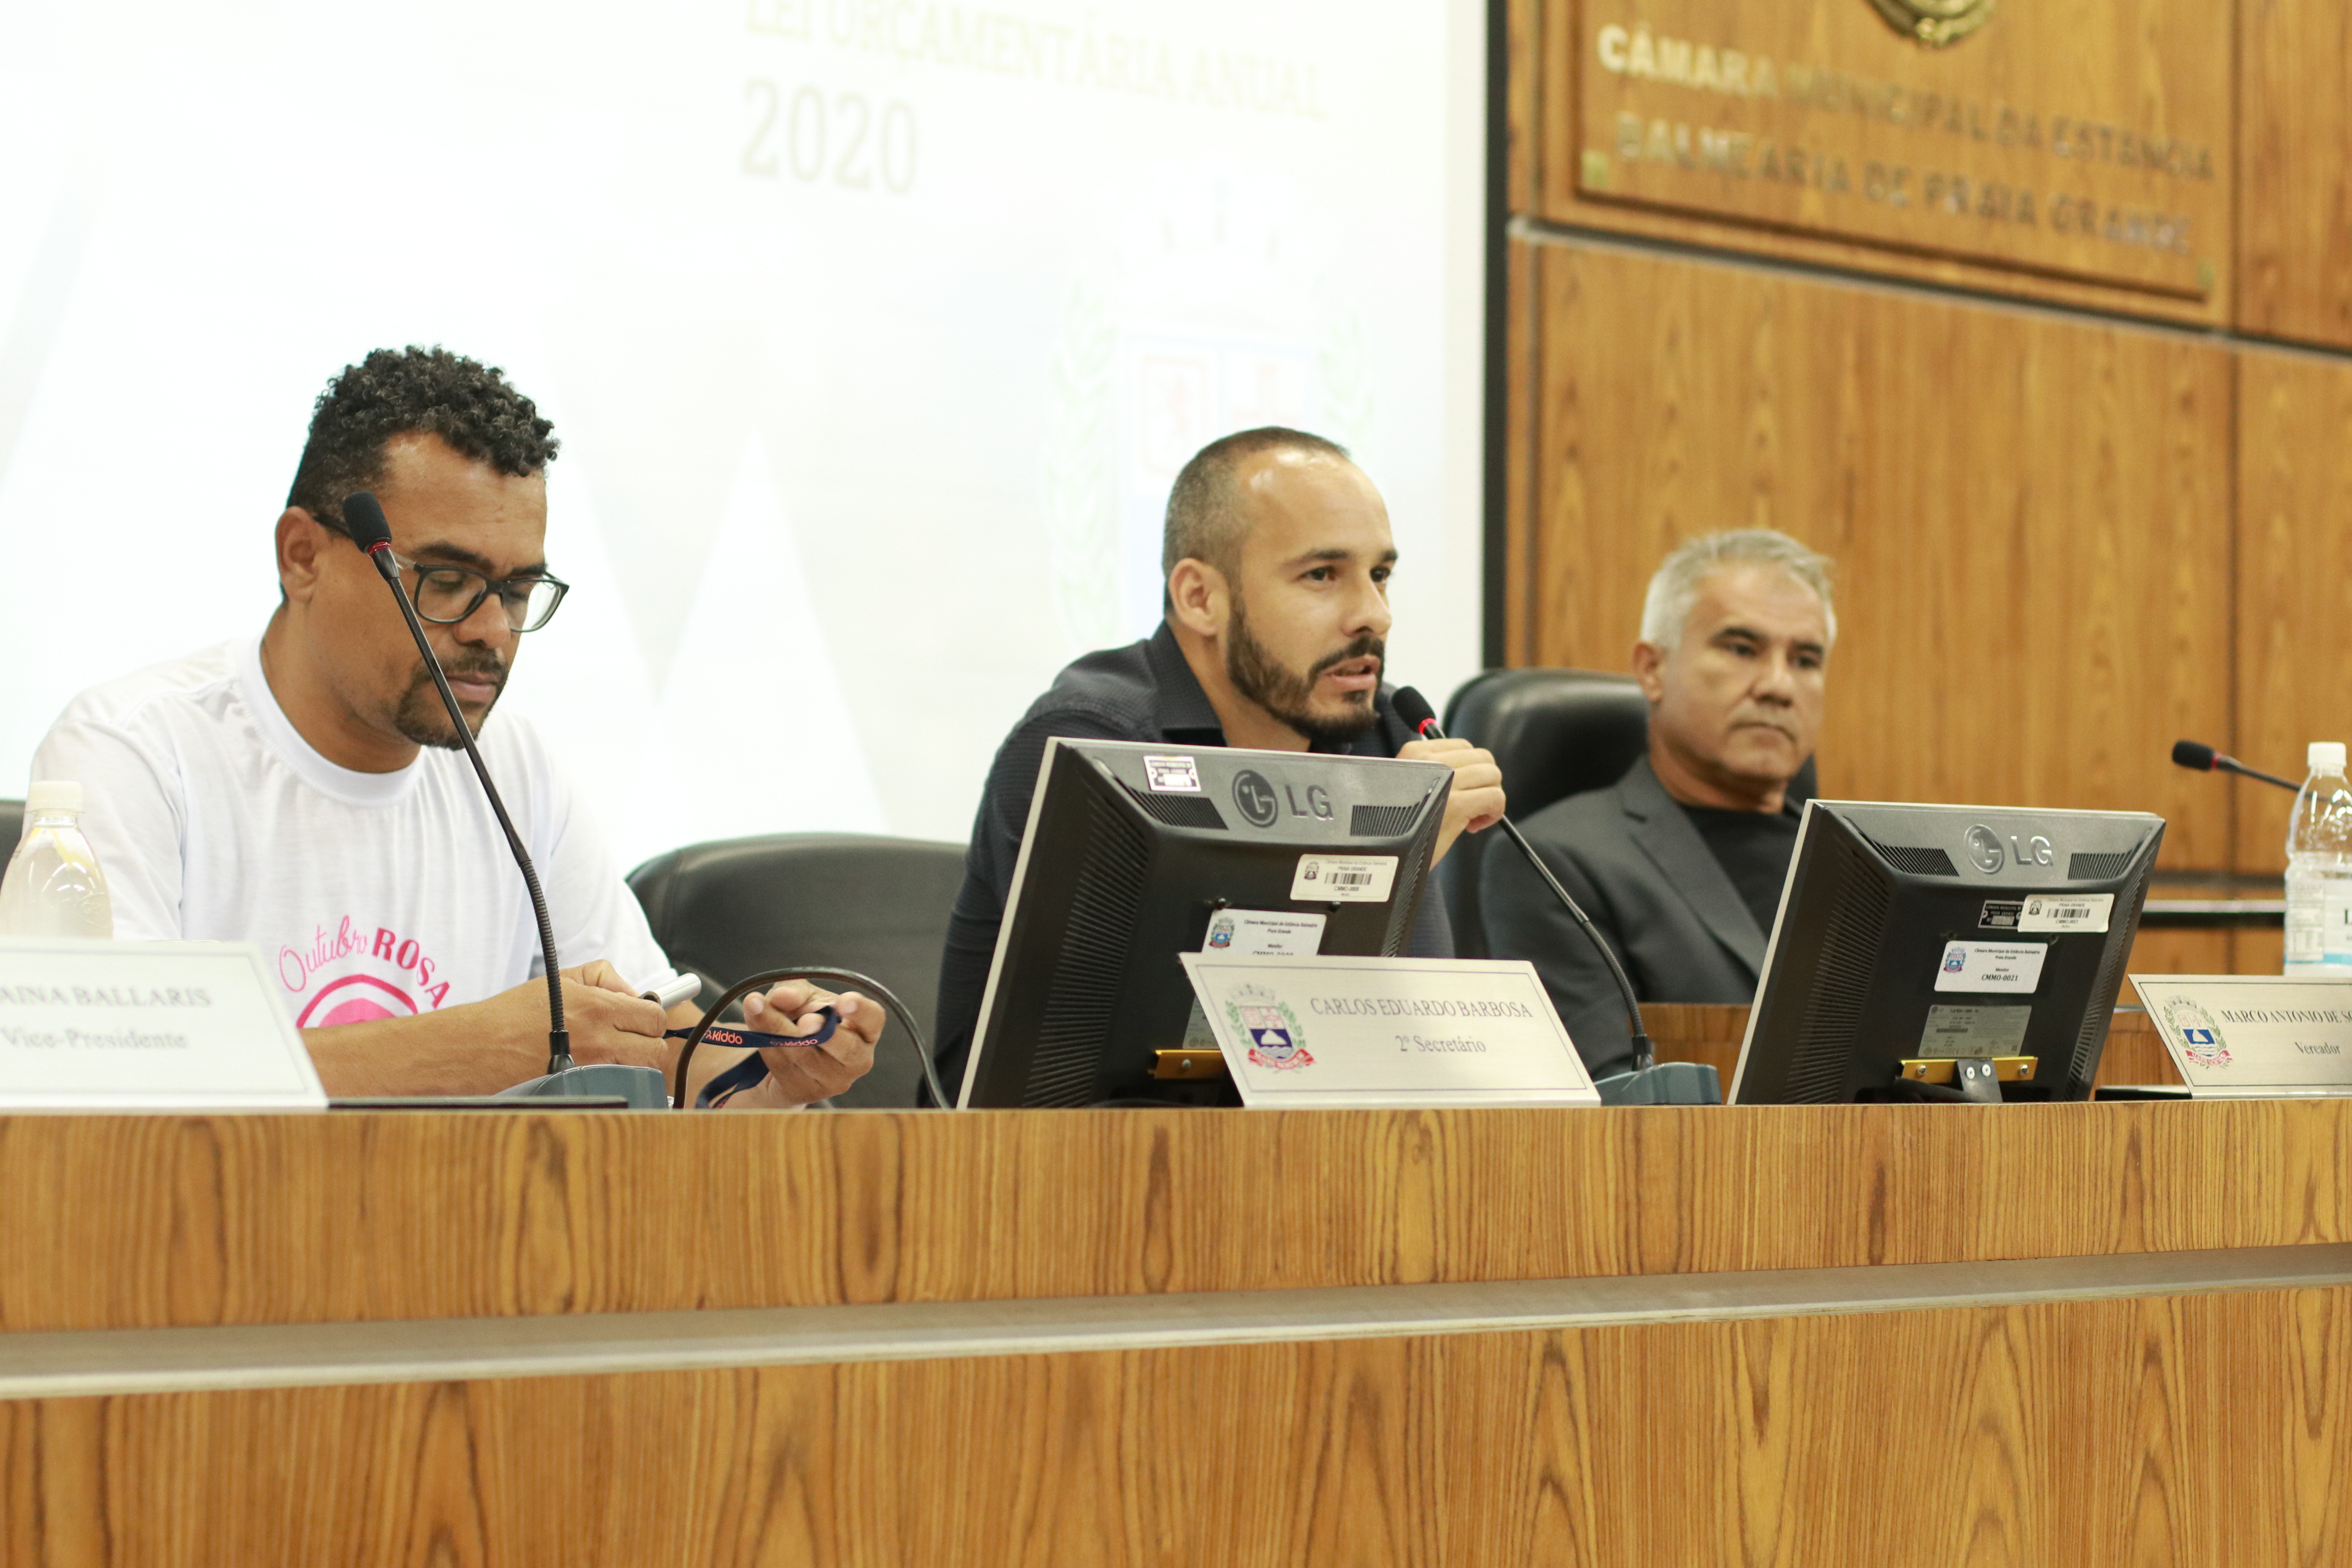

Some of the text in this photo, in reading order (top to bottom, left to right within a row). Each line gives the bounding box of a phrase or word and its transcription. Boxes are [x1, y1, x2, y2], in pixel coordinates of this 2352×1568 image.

[1186, 45, 1329, 121] ANUAL
[1597, 20, 1778, 98] CÂMARA
[1996, 105, 2042, 150] DA
[740, 74, 920, 195] 2020
[1864, 161, 1910, 208] DE
[1923, 172, 2037, 229] PRAIA
[2049, 191, 2192, 256] GRANDE
[1283, 783, 1334, 821] LG
[2011, 835, 2053, 866] LG
[279, 914, 450, 1009] Outubro ROSA
[71, 985, 212, 1007] BALLARIS
[1310, 997, 1534, 1018] CARLOS EDUARDO BARBOSA
[2221, 1010, 2269, 1023] MARCO
[2270, 1010, 2324, 1023] ANTONIO
[2323, 1010, 2342, 1023] DE
[0, 1026, 189, 1049] Vice-Presidente
[1413, 1035, 1487, 1053] Secretário
[2295, 1042, 2341, 1054] Vereador
